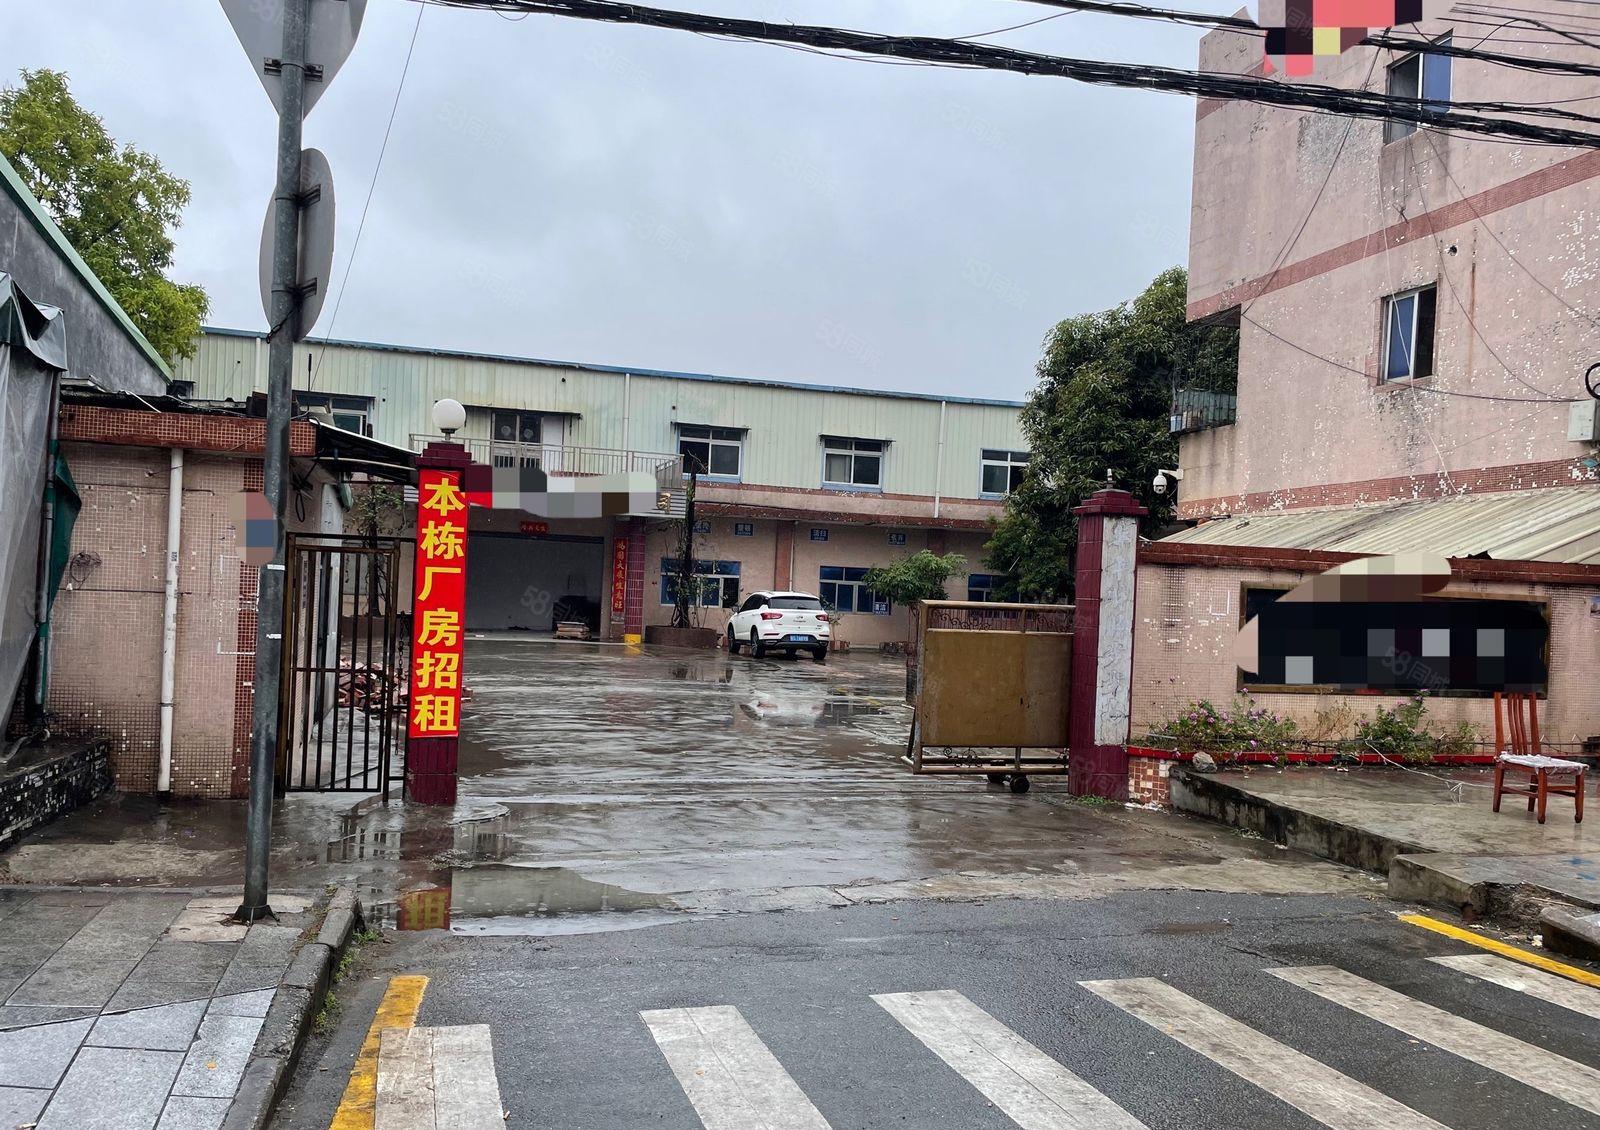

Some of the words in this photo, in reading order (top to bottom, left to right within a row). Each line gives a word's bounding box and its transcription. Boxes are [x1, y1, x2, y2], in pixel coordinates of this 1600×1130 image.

[414, 477, 465, 732] 本栋厂房招租
